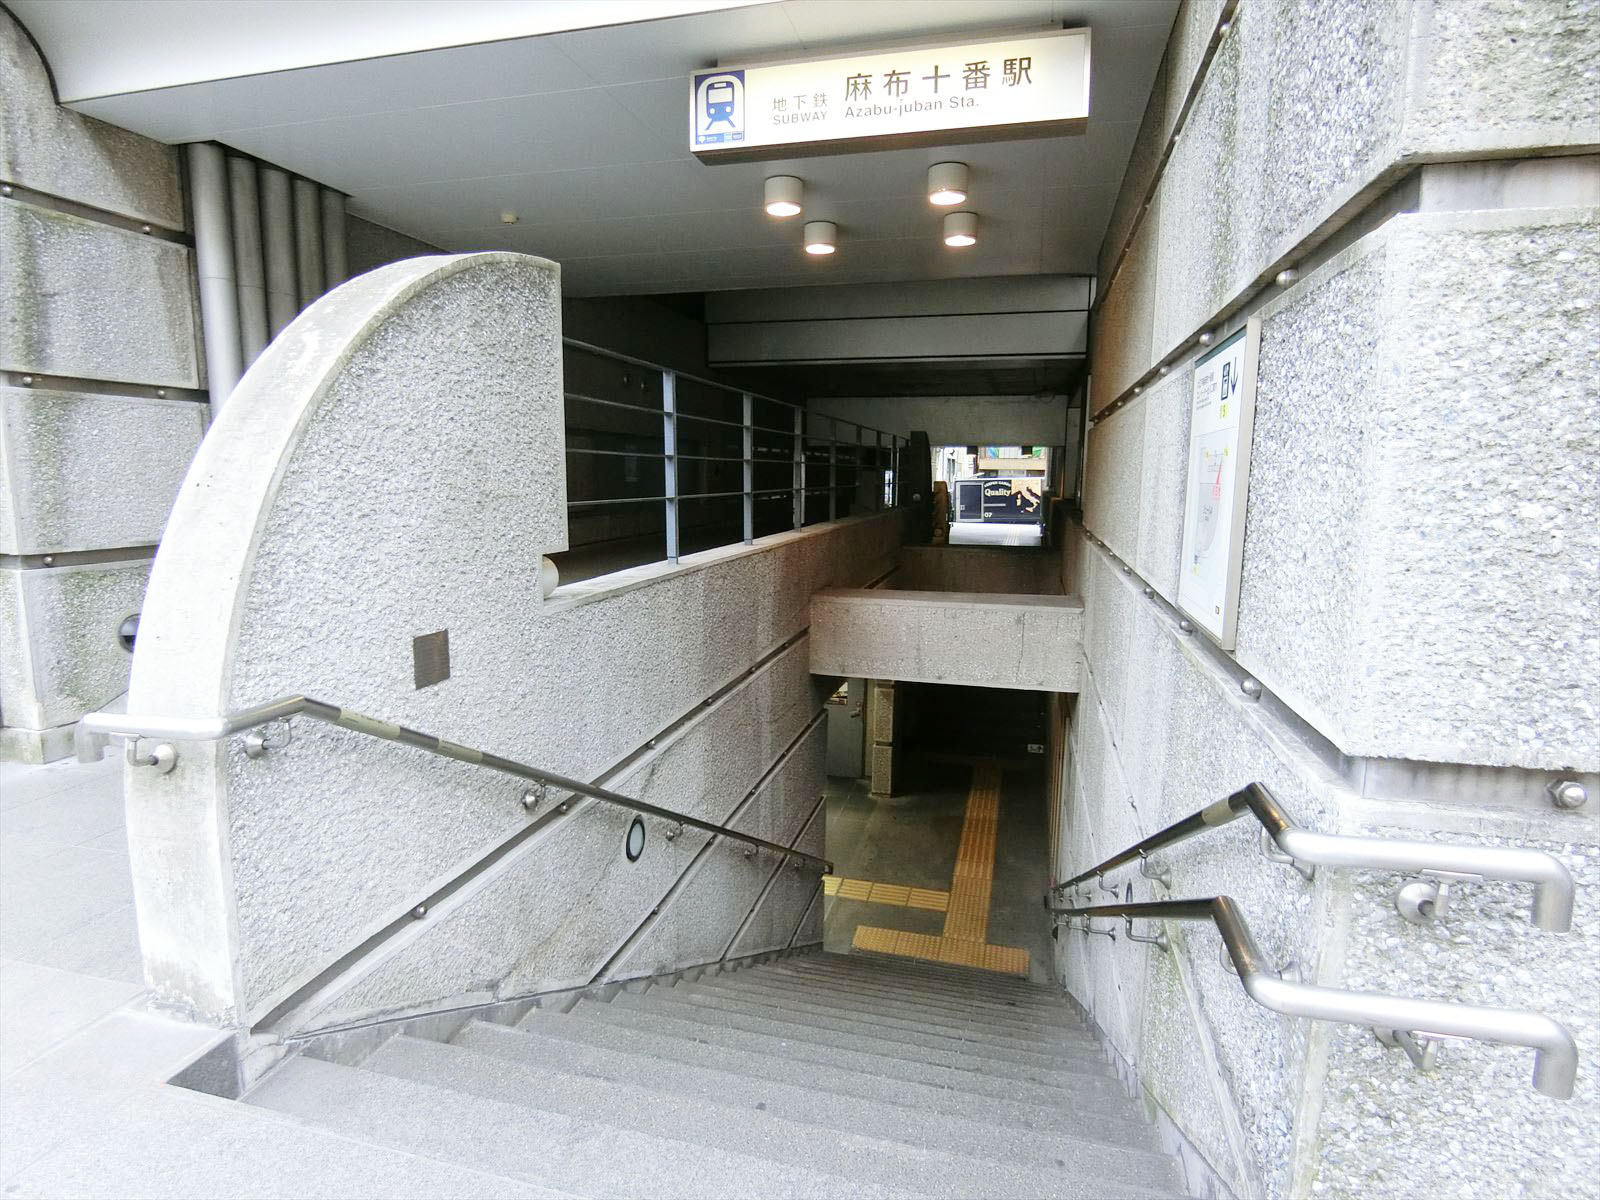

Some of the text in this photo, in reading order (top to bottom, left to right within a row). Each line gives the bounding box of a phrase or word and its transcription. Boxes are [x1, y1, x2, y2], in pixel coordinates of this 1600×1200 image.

[844, 56, 1033, 102] 麻布十番駅
[772, 92, 828, 112] 地下鉄
[844, 95, 980, 118] Azabu-juban Sta.
[773, 110, 828, 126] SUBWAY
[984, 488, 1011, 497] Quality
